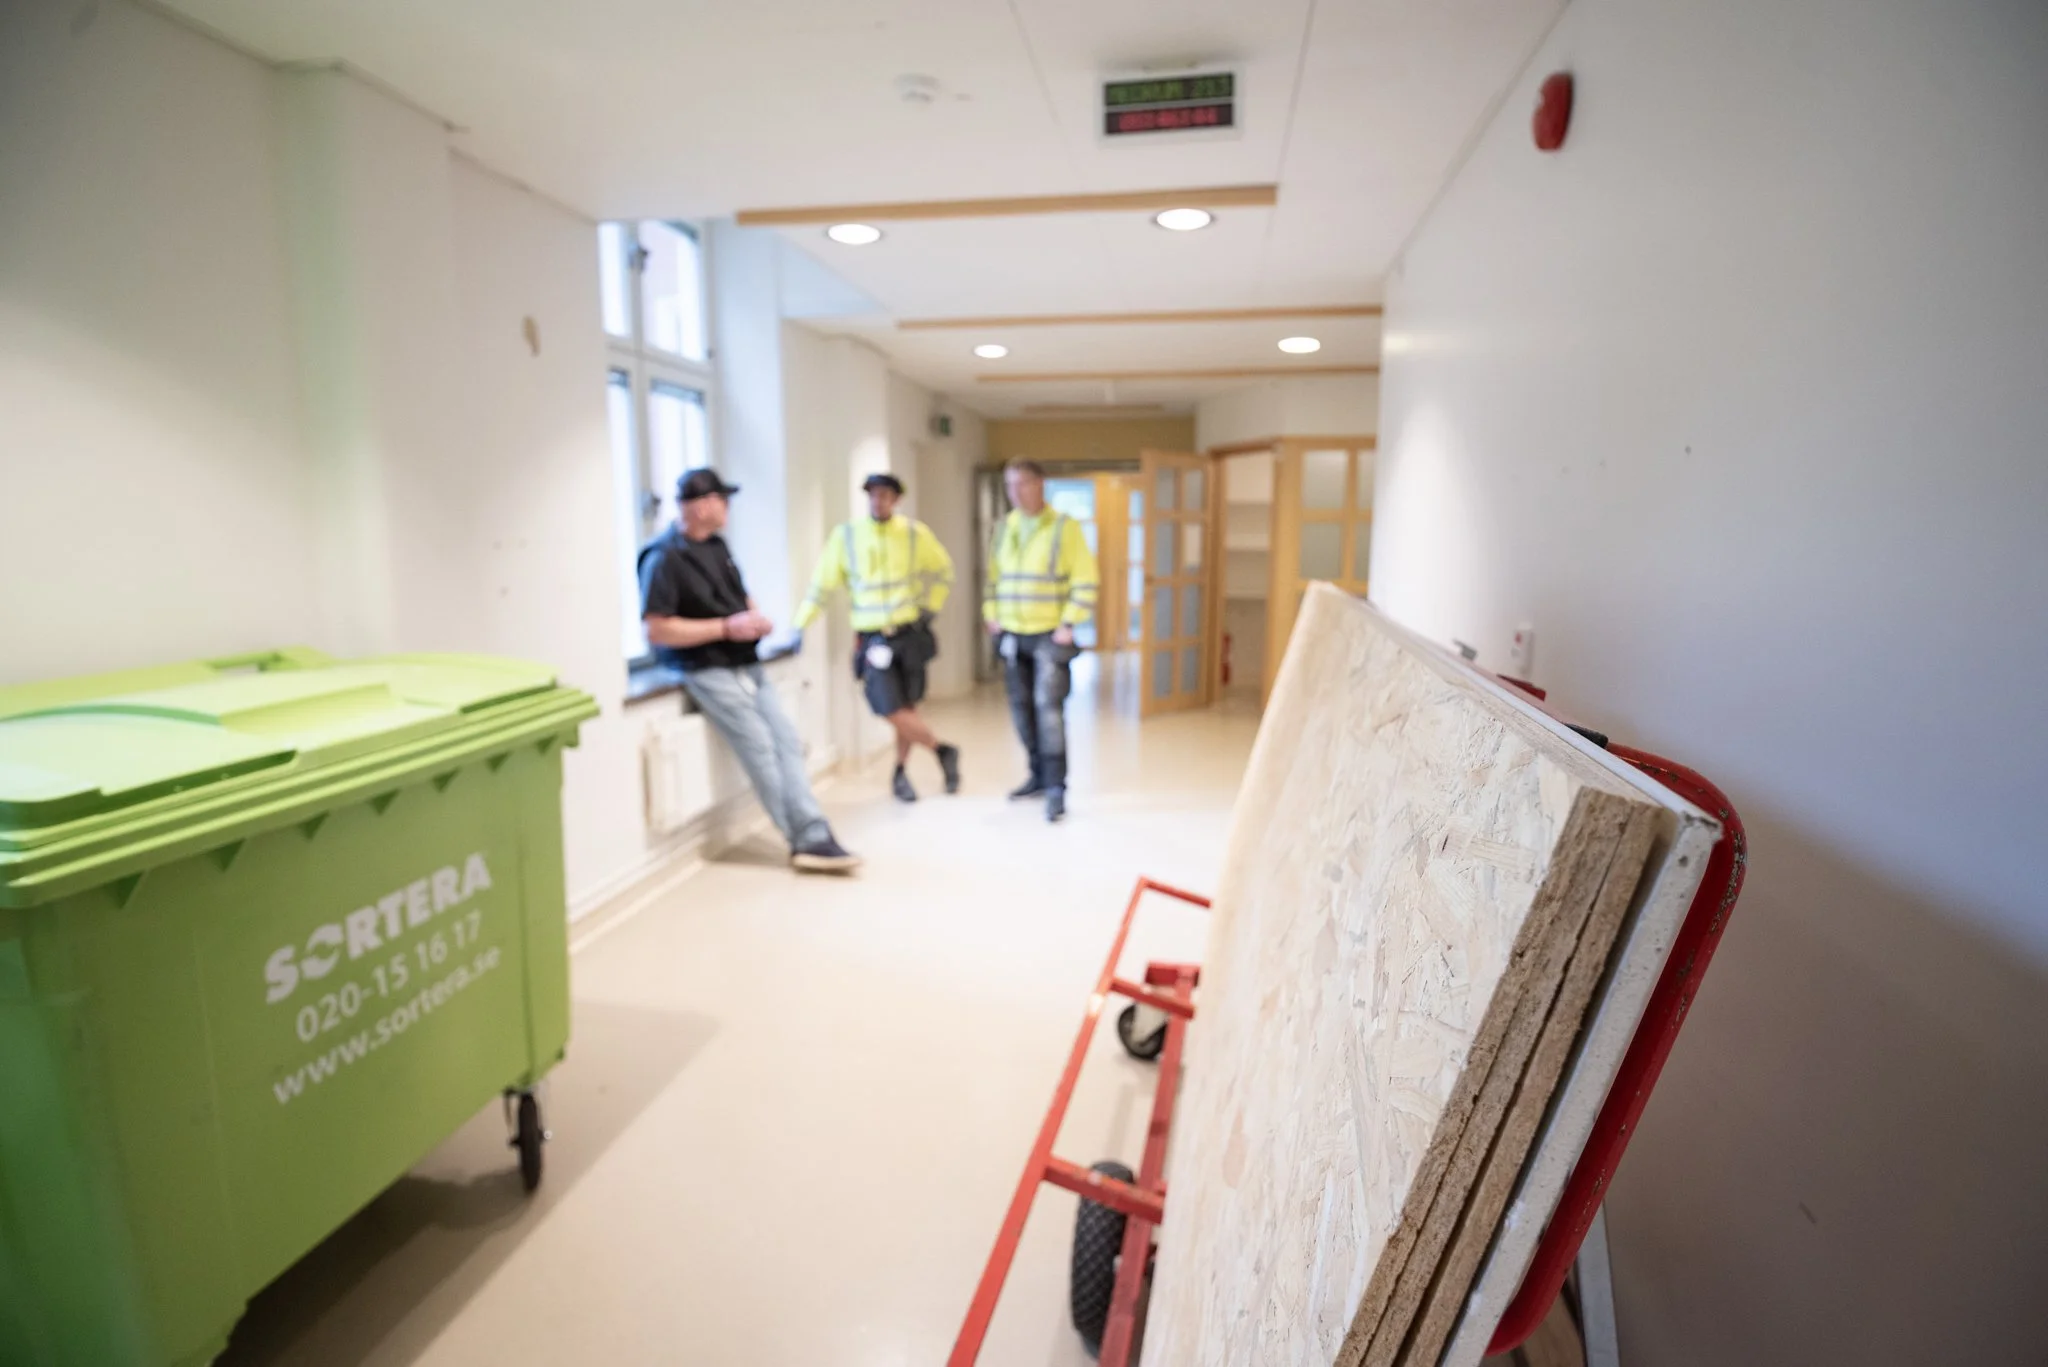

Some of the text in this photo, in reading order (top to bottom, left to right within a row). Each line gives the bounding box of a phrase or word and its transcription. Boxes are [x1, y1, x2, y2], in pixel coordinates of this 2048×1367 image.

[264, 853, 492, 1005] SORTERA
[296, 908, 482, 1042] 020-15 16 17
[273, 946, 500, 1104] www.sortera.se
